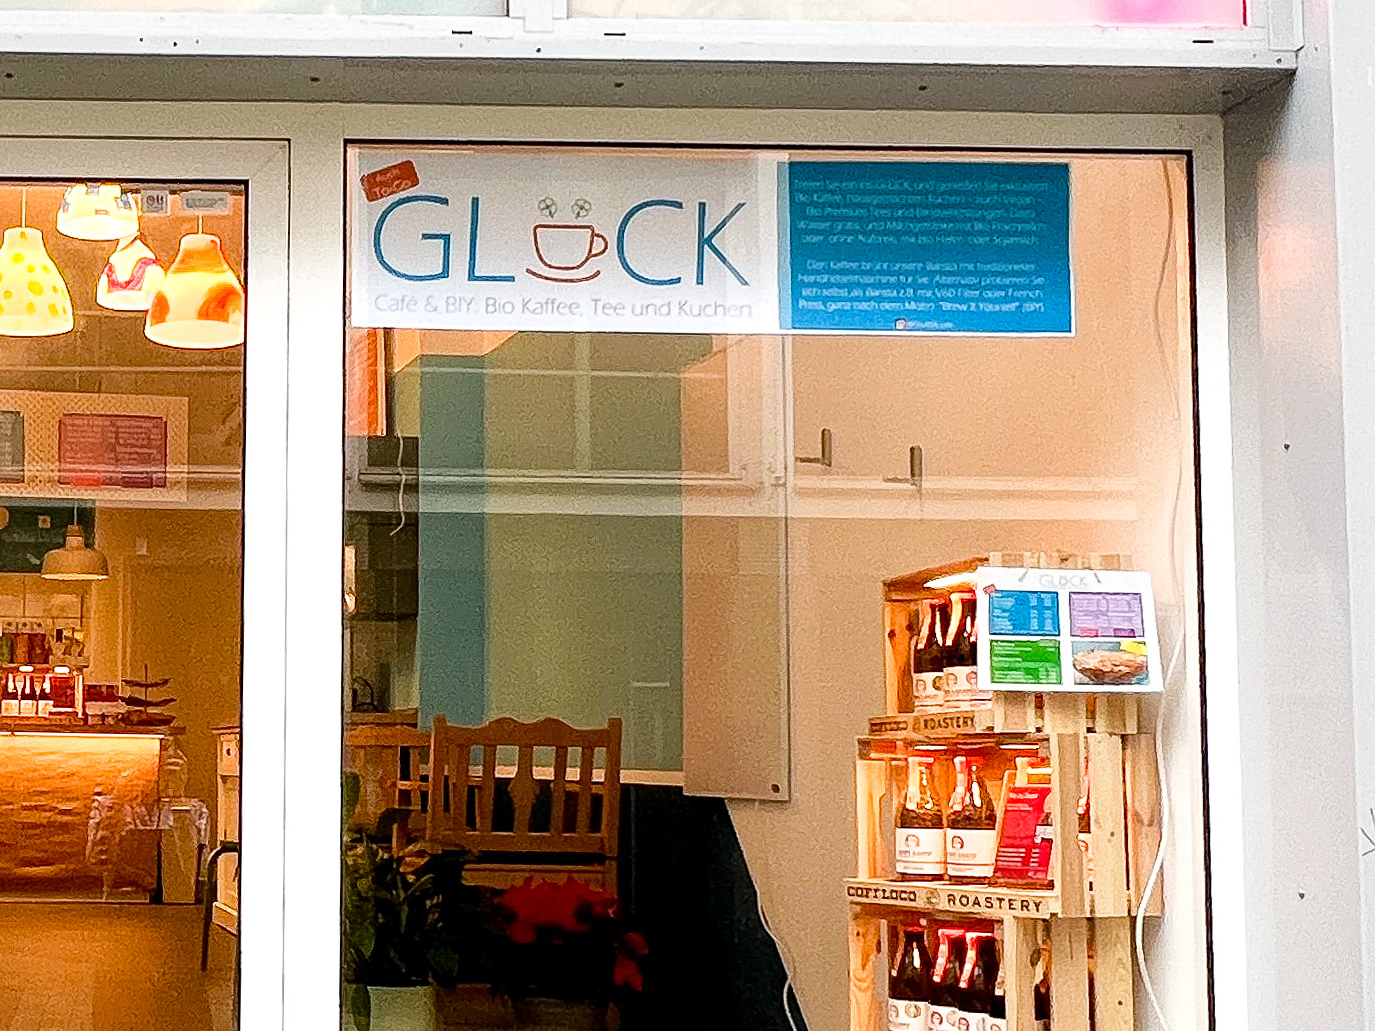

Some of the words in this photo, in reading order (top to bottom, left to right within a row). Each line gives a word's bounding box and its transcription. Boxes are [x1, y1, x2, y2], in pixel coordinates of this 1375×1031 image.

[374, 294, 418, 312] Café
[425, 295, 438, 313] &
[485, 297, 515, 315] Bio
[591, 298, 626, 316] Tee
[631, 300, 671, 317] und
[678, 300, 753, 318] Kuchen
[946, 893, 1043, 914] ROASTERY
